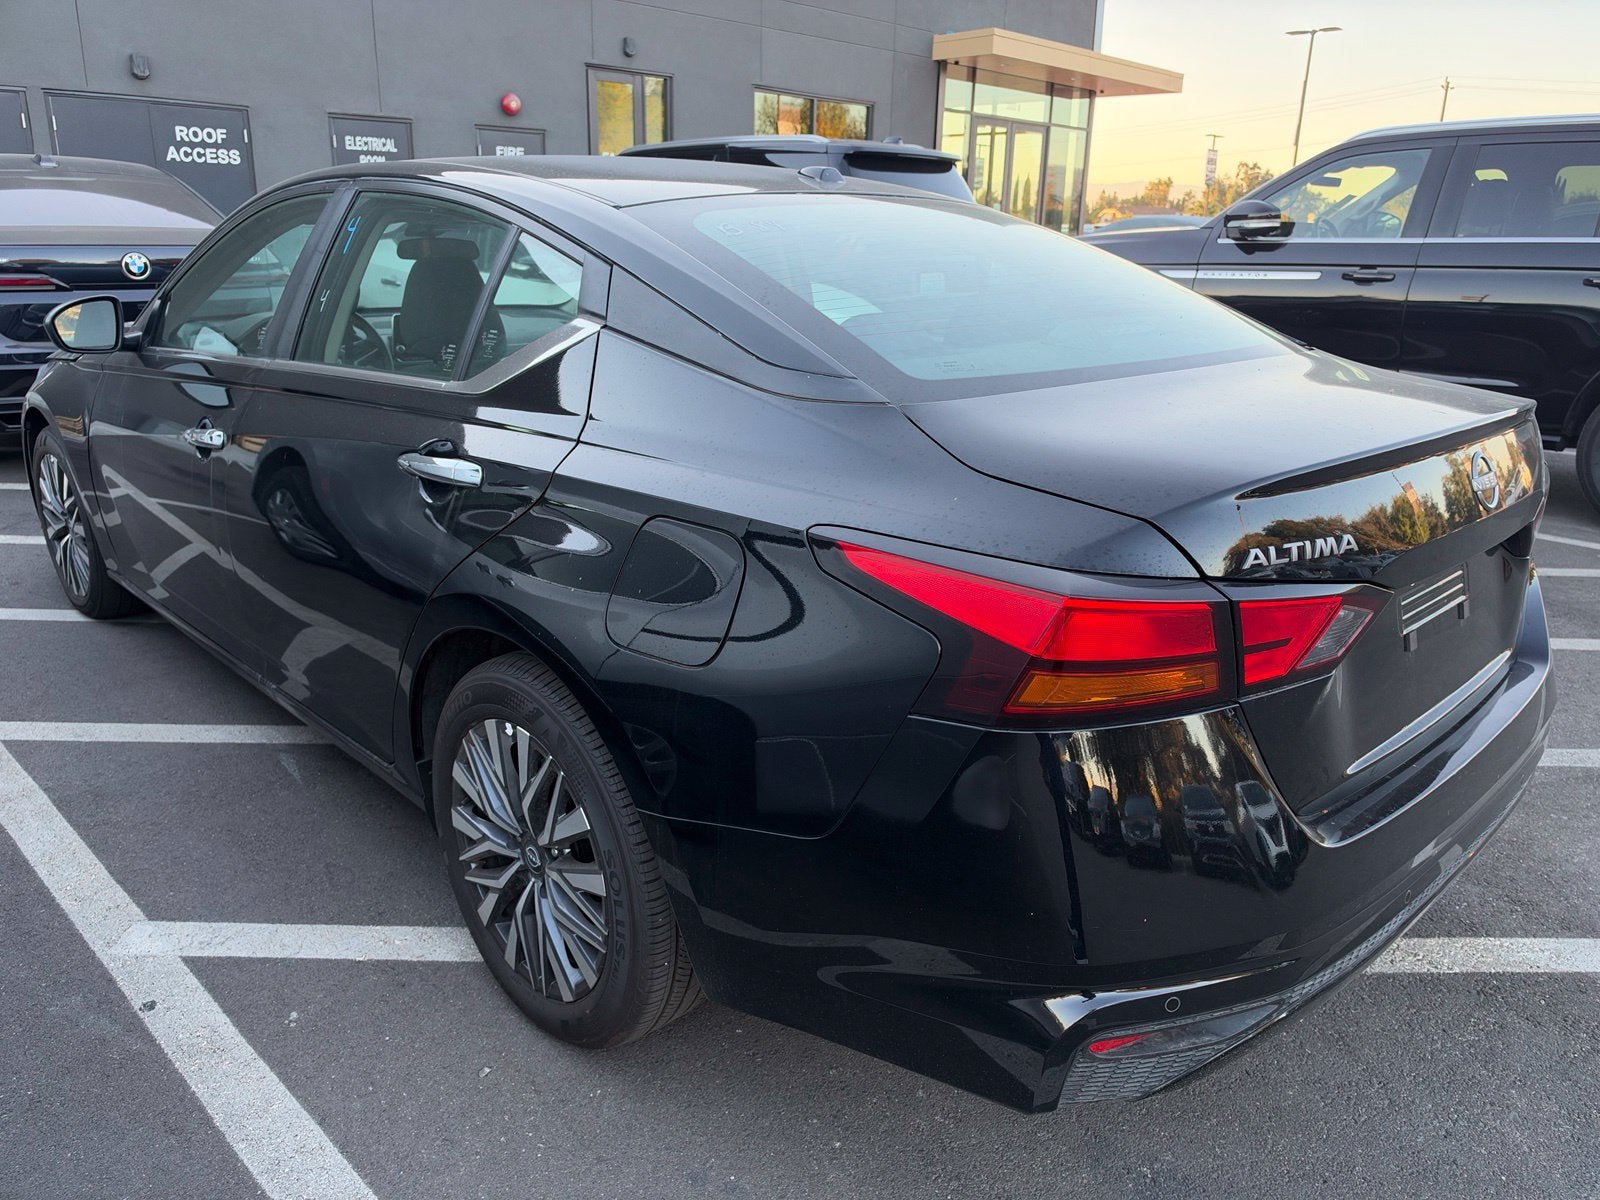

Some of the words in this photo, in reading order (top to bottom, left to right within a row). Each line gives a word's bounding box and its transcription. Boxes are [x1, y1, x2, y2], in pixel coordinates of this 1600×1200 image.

[174, 125, 227, 144] ROOF
[344, 135, 398, 153] ELECTRICAL
[165, 145, 242, 166] ACCESS
[495, 145, 525, 157] FIRE
[343, 215, 362, 255] 4
[320, 289, 331, 313] 4
[1241, 533, 1360, 570] ALTIMA
[603, 848, 626, 960] SOLUS
